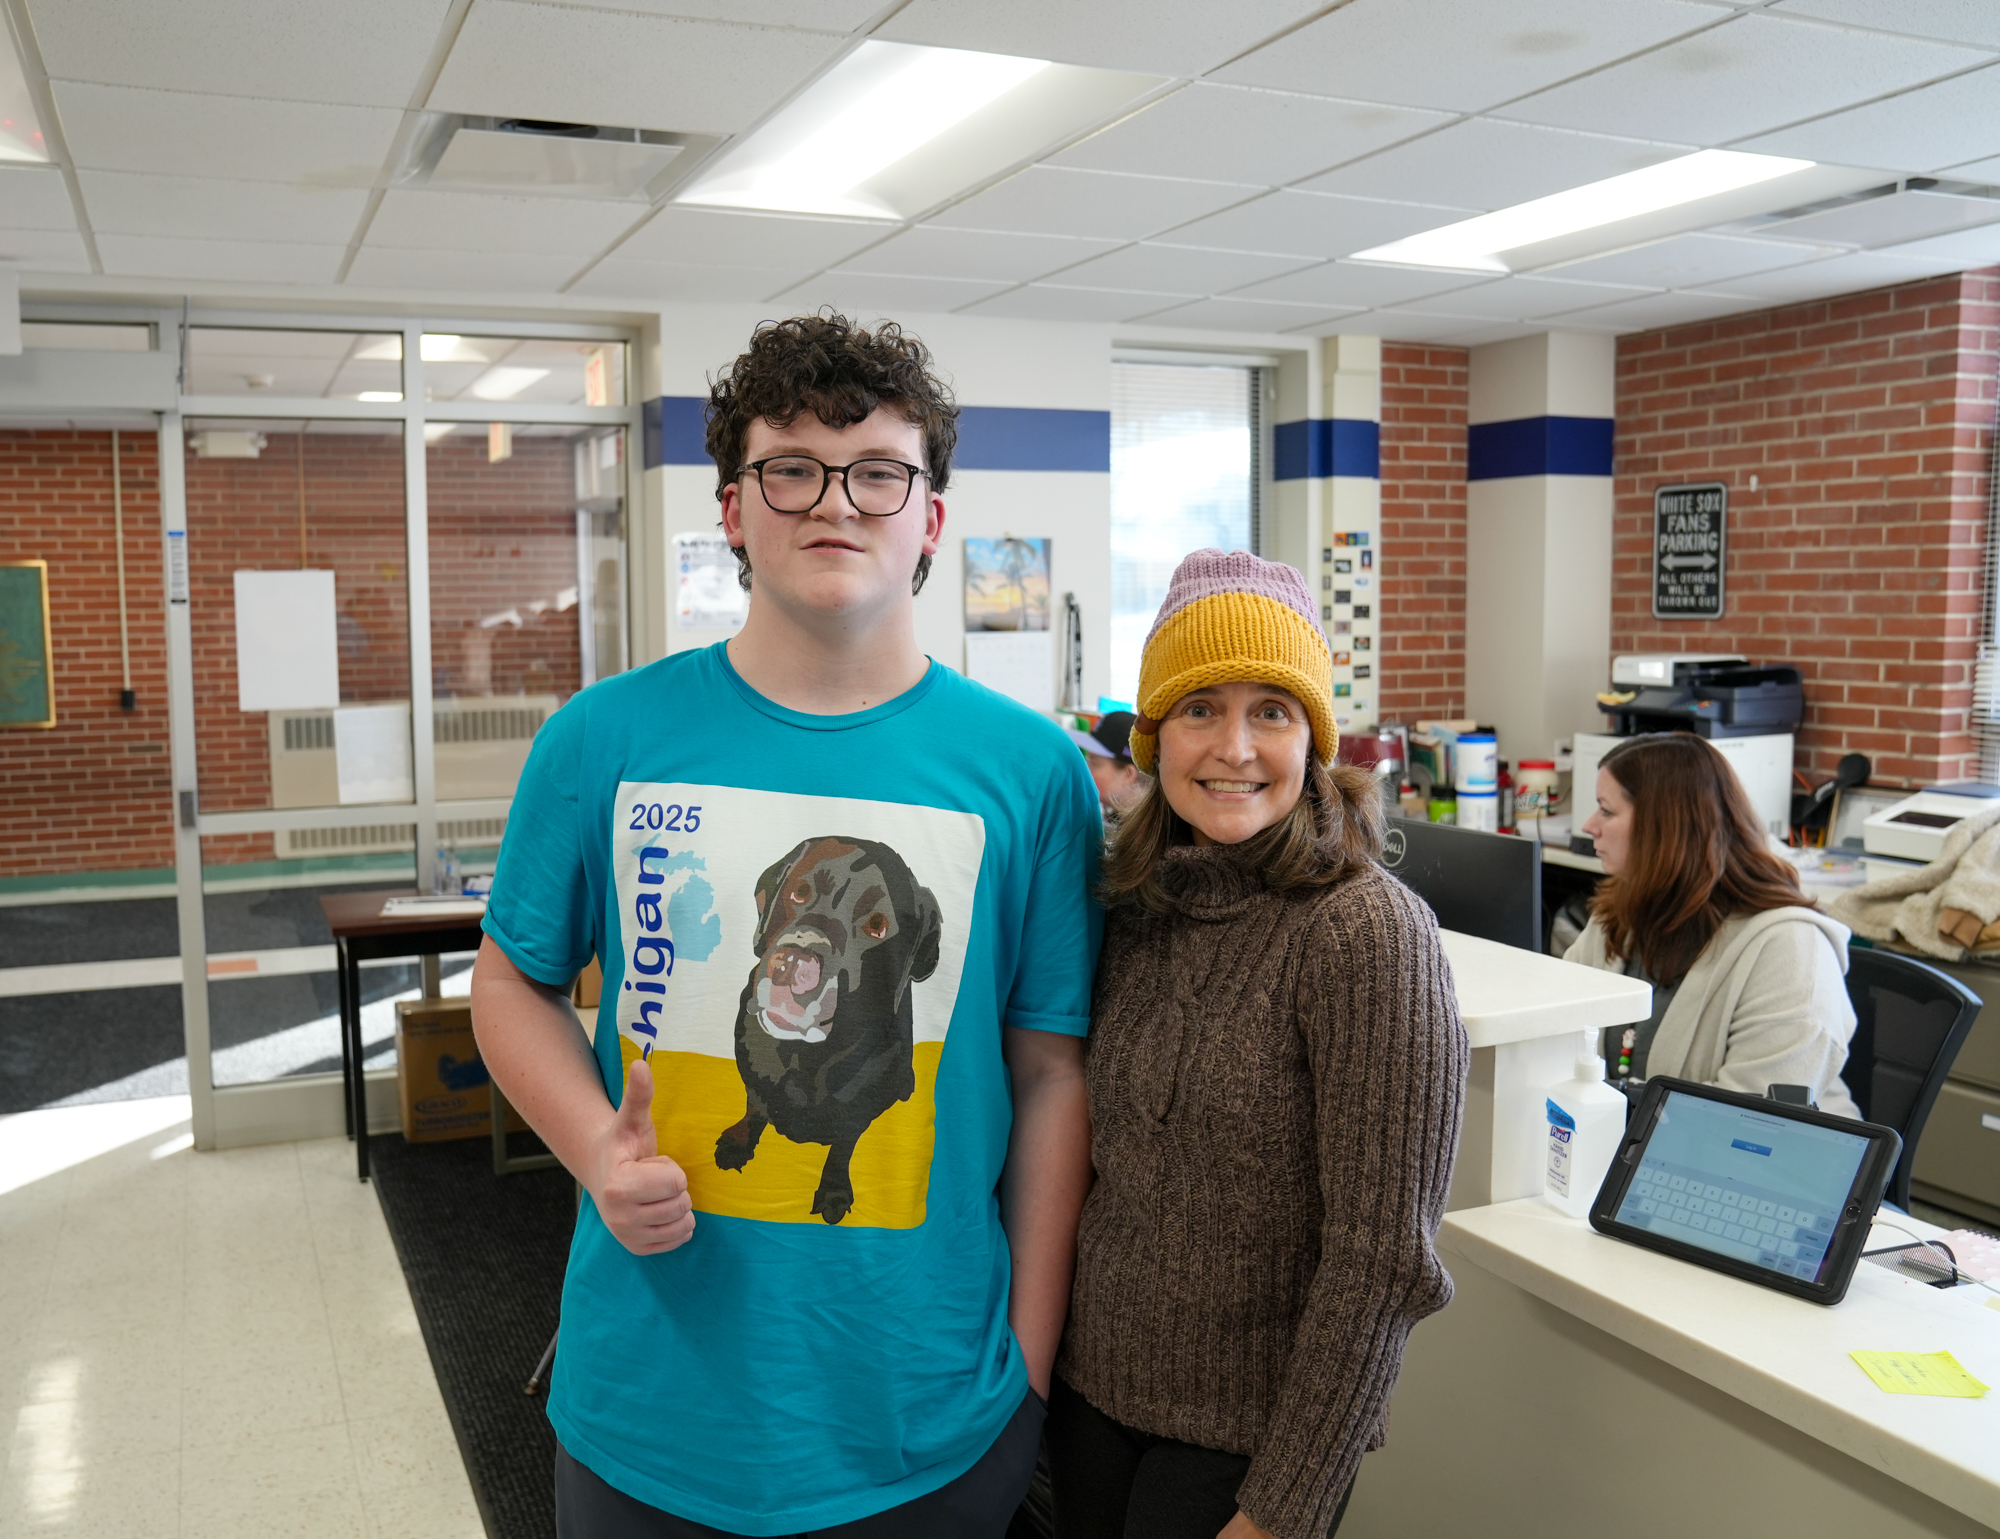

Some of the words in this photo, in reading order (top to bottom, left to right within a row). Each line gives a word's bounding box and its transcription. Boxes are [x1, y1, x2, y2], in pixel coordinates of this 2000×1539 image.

[1661, 494, 1693, 514] WHITE
[1696, 493, 1720, 512] SOX
[1667, 513, 1711, 533] FANS
[1660, 531, 1719, 553] PARKING
[1660, 573, 1677, 584] ALL
[1680, 572, 1717, 584] OTHERS
[1668, 585, 1689, 595] WILL
[1693, 584, 1707, 595] BE
[1659, 596, 1696, 607] THROWN
[1698, 595, 1717, 607] OUT
[630, 803, 702, 833] 2025
[1552, 1126, 1569, 1142] Purell
